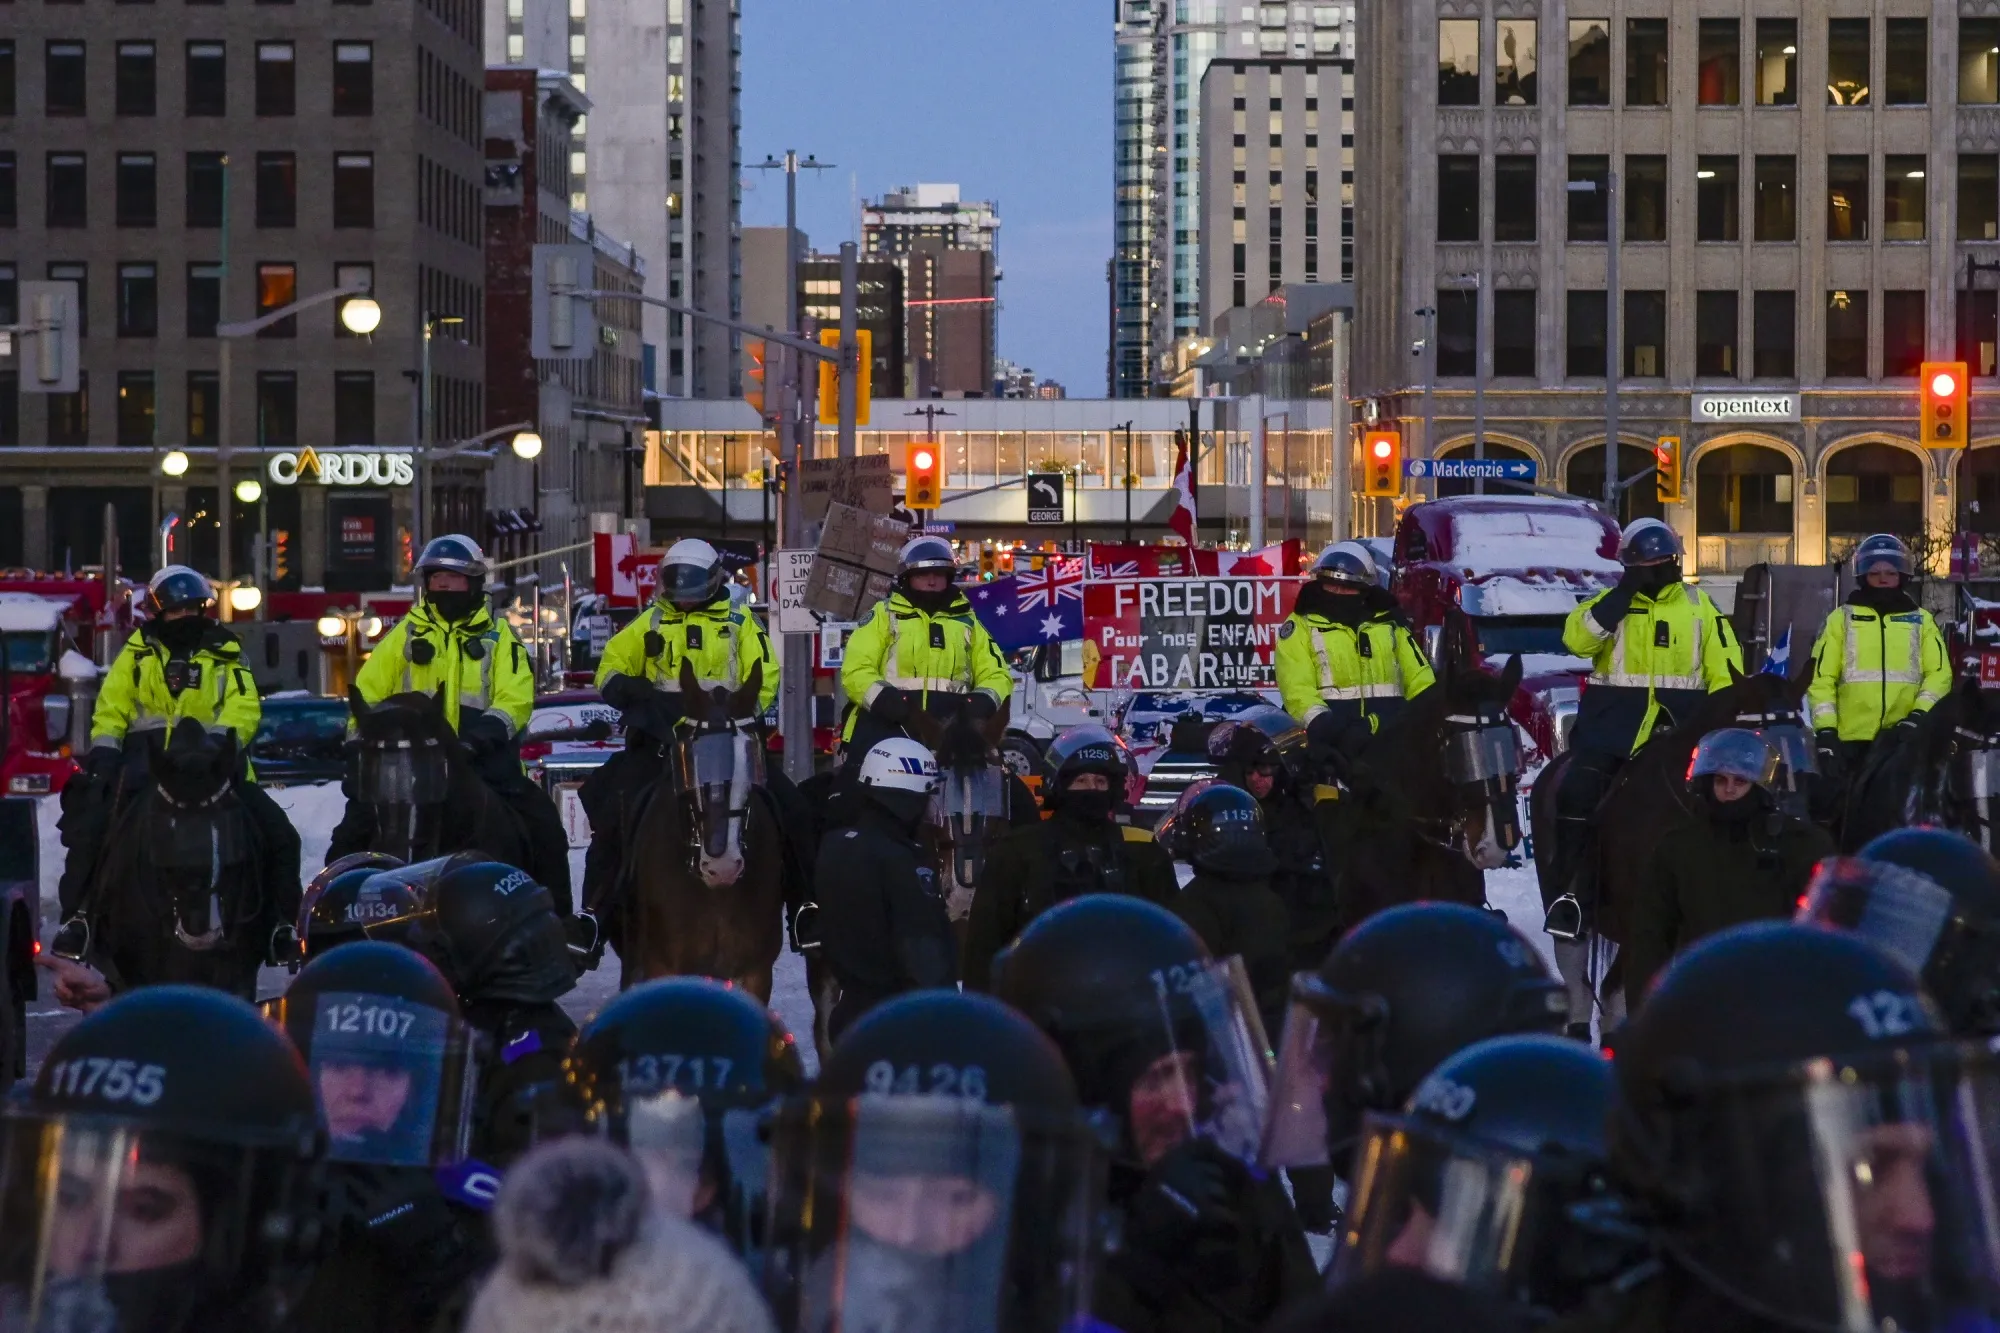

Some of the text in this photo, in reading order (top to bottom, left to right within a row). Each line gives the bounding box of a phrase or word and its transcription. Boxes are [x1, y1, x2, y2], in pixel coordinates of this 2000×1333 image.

[1703, 398, 1791, 417] opentext
[268, 445, 414, 486] CARDUS
[1432, 460, 1504, 477] Mackenzie
[1031, 511, 1061, 521] GEORGE
[926, 524, 949, 533] ussex
[793, 568, 809, 578] LIN
[783, 598, 801, 609] D'A
[1115, 581, 1281, 619] FREEDOM
[1102, 626, 1148, 648] Pour
[1162, 632, 1197, 647] nos
[871, 748, 892, 759] POLICE
[1076, 748, 1110, 761] 11258
[344, 902, 399, 920] 10134
[326, 1003, 417, 1039] 12107
[51, 1057, 167, 1106] 11755
[617, 1054, 734, 1091] 13717
